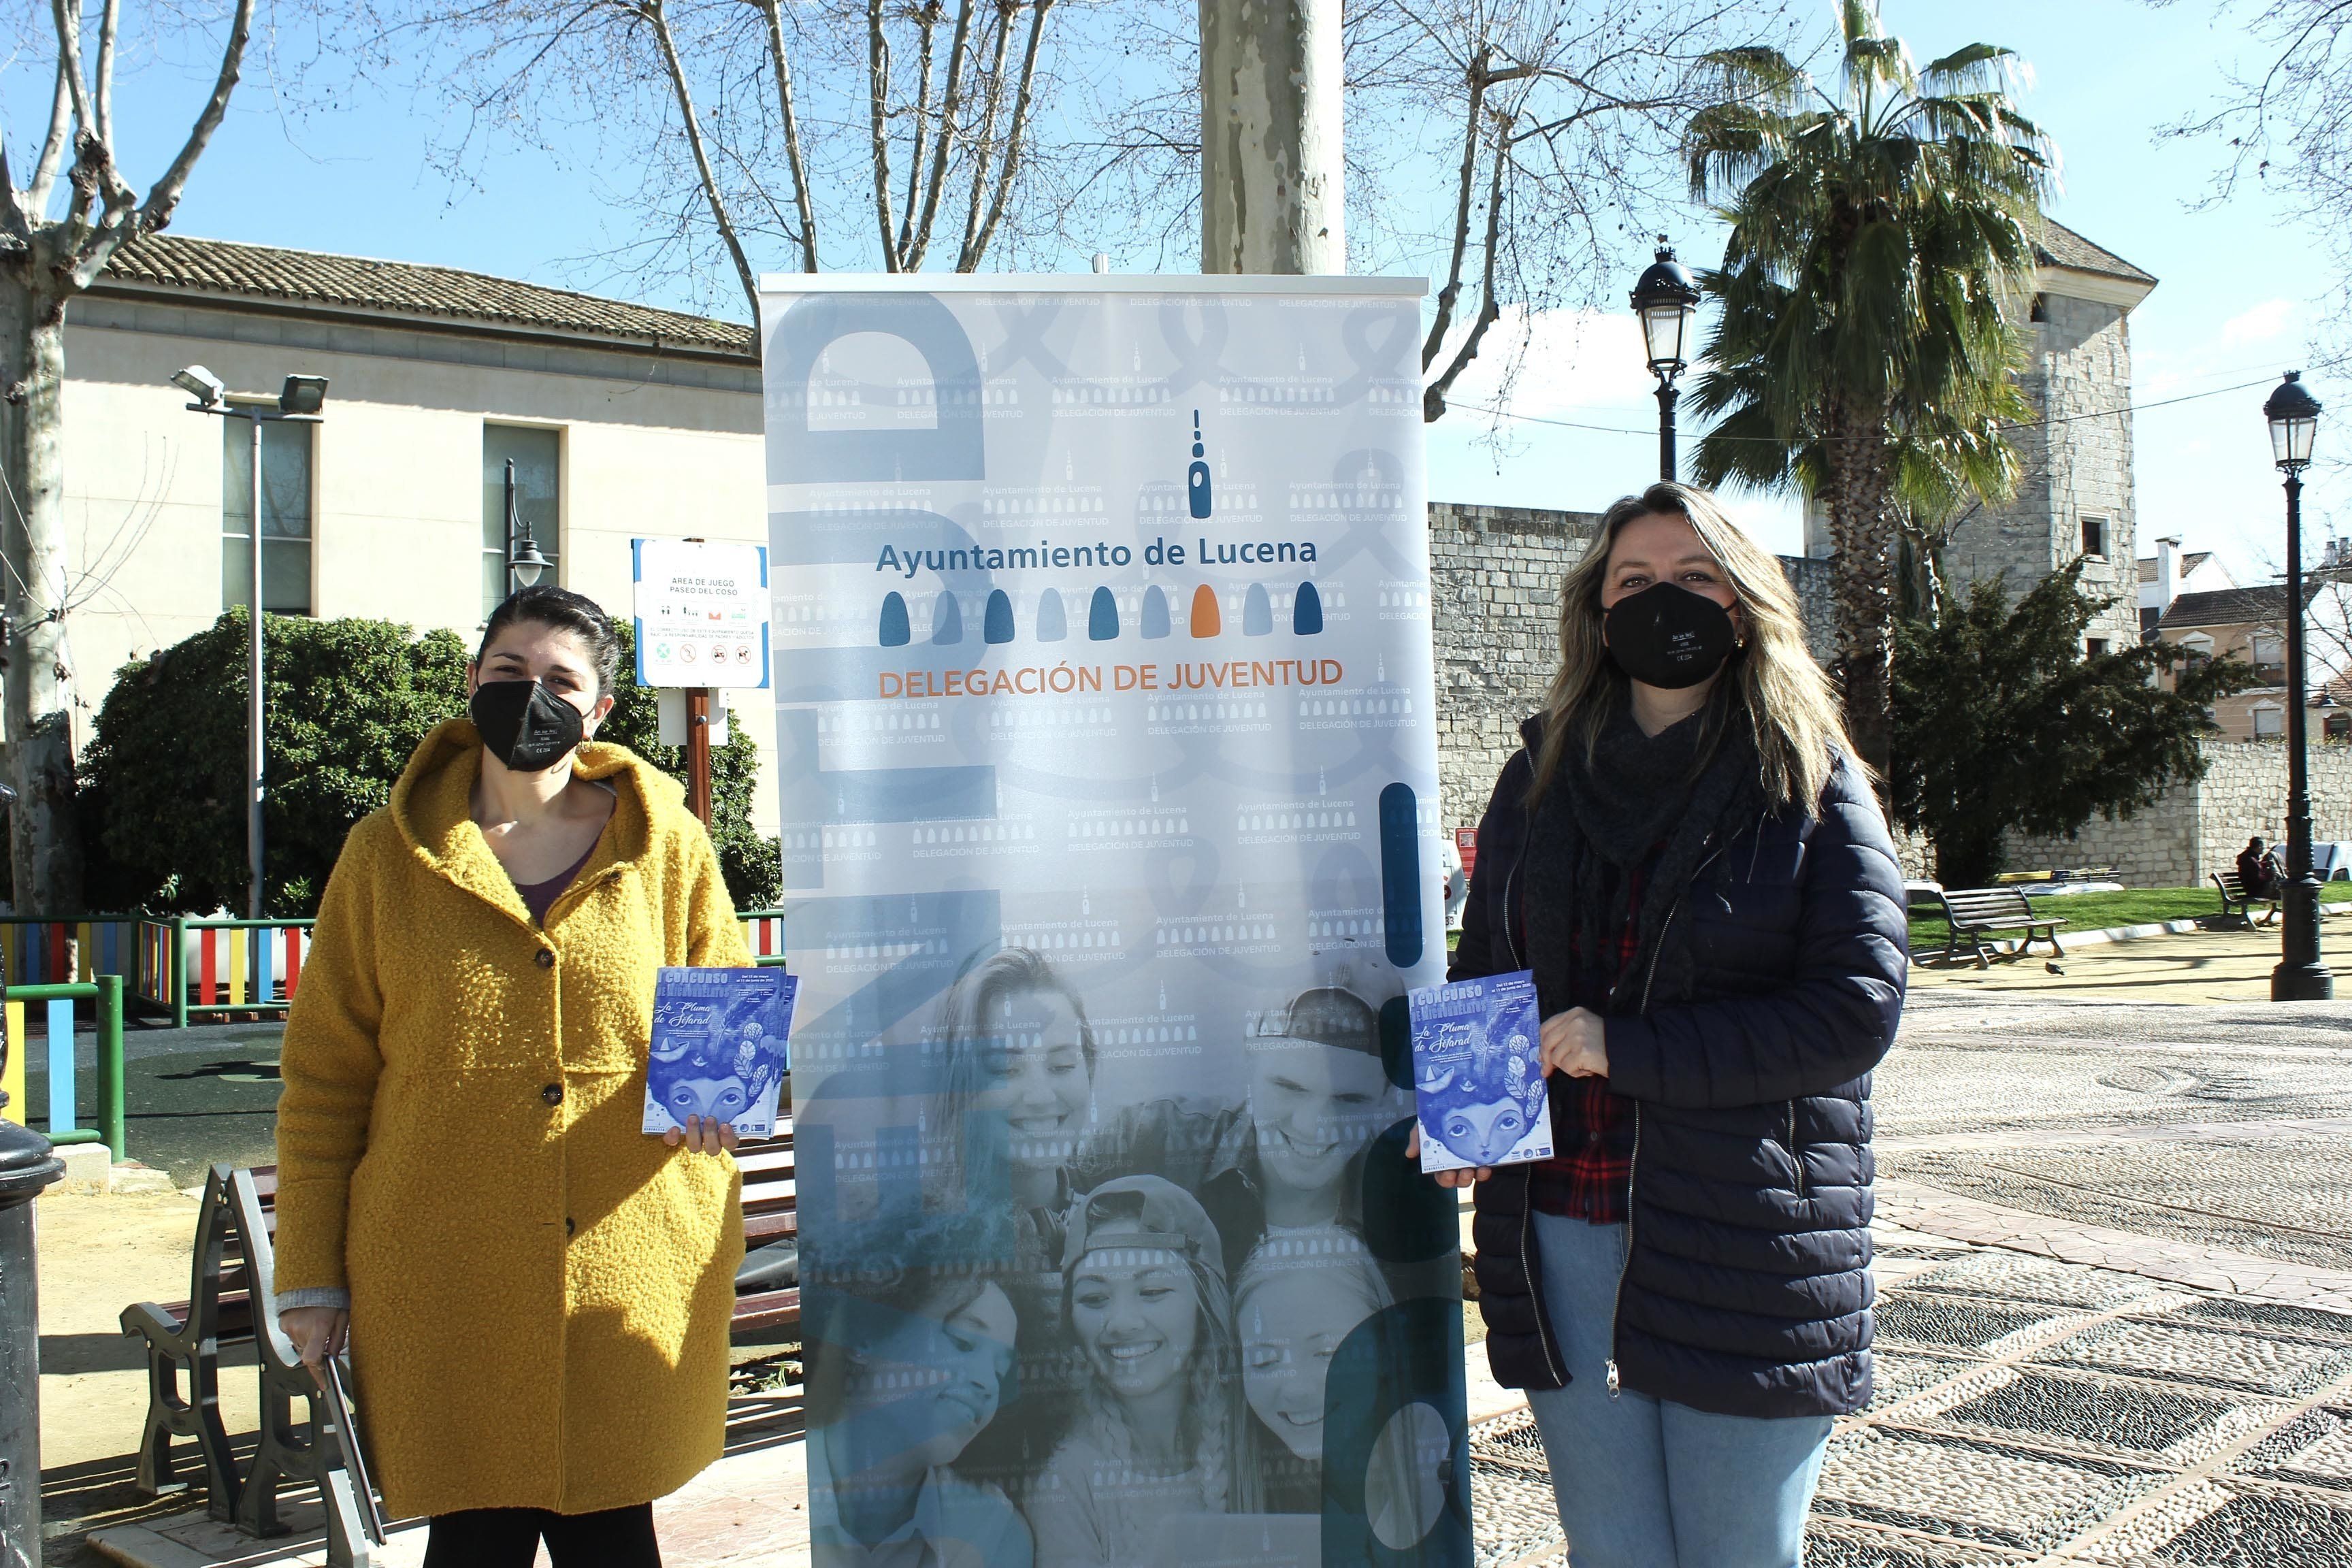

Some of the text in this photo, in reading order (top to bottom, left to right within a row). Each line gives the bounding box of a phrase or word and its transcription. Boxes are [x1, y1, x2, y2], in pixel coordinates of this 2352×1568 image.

[975, 297, 1100, 306] DELEGACIÓN DE JUVENTUD
[1130, 297, 1252, 307] DELEGACIÓN DE JUVENTUD
[1279, 299, 1396, 310] DELEGACIÓN DE JUVENTUD
[825, 378, 860, 387] Lucena
[983, 377, 1018, 386] Lucena
[1051, 376, 1170, 387] Ayuntamiento de Lucena
[1218, 376, 1334, 385] Ayuntamiento de Lucena
[816, 411, 866, 420] JUVENTUD
[1051, 409, 1177, 419] DELEGACIÓN DE JUVENTUD
[1219, 408, 1341, 416] DELEGACIÓN DE JUVENTUD
[981, 484, 1102, 496] Ayuntamiento de Lucena
[1222, 482, 1257, 491] Lucena
[1288, 480, 1401, 491] Ayuntamiento de Lucena
[810, 487, 931, 498] Ayuntamiento de Lucena
[983, 517, 1110, 529] DELEGACIÓN DE JUVENTUD
[1213, 514, 1263, 523] JUVENTUD
[1289, 514, 1408, 523] DELEGACIÓN DE JUVENTUD
[876, 538, 1318, 579] Ayuntamiento de Lucena
[708, 579, 734, 587] JUEGO
[670, 586, 696, 594] PASEO
[879, 658, 1344, 698] DELEGACIÓN DE JUVENTUD
[1147, 690, 1265, 702] Ayuntamiento de Lucena
[1298, 687, 1411, 698] Ayuntamiento de Lucena
[889, 700, 938, 710] de Lucena
[1147, 723, 1272, 734] DELEGACIÓN DE JUVENTUD
[1298, 719, 1417, 730] DELEGACIÓN DE JUVENTUD
[894, 734, 945, 745] JUVENTUD
[1237, 799, 1354, 812] Ayuntamiento de Lucena
[1067, 805, 1188, 820] Ayuntamiento de Lucena
[1237, 832, 1361, 845] DELEGACIÓN DE JUVENTUD
[1067, 838, 1194, 852] DELEGACIÓN DE JUVENTUD
[913, 845, 1040, 859] DELEGACIÓN DE JUVENTUD
[1156, 911, 1274, 926] Ayuntamiento de Lucena
[1307, 909, 1374, 919] Ayuntamiento
[1071, 918, 1119, 930] de Lucena
[912, 926, 947, 936] Lucena
[1156, 944, 1281, 958] DELEGACIÓN DE JUVENTUD
[1308, 940, 1367, 951] DELEGACIÓN
[1061, 951, 1126, 962] DE JUVENTUD
[825, 961, 887, 973] DELEGACIÓN
[666, 972, 728, 984] CONCURSO
[1418, 984, 1483, 1006] CONCURSO
[654, 1001, 711, 1015] La Pluma
[1422, 1000, 1487, 1021] MICRORRELATOS
[654, 1013, 712, 1028] de Sefarad
[1145, 1012, 1195, 1024] de Lucena
[992, 1019, 1041, 1032] de Lucena
[1413, 1022, 1470, 1042] La Pluma
[1245, 1040, 1305, 1051] DELEGACIÓN
[1414, 1033, 1471, 1053] de Sefarad
[1139, 1046, 1202, 1058] DE JUVENTUD
[835, 1171, 897, 1183] DELEGACIÓN
[1254, 1260, 1314, 1271] DELEGACIÓN
